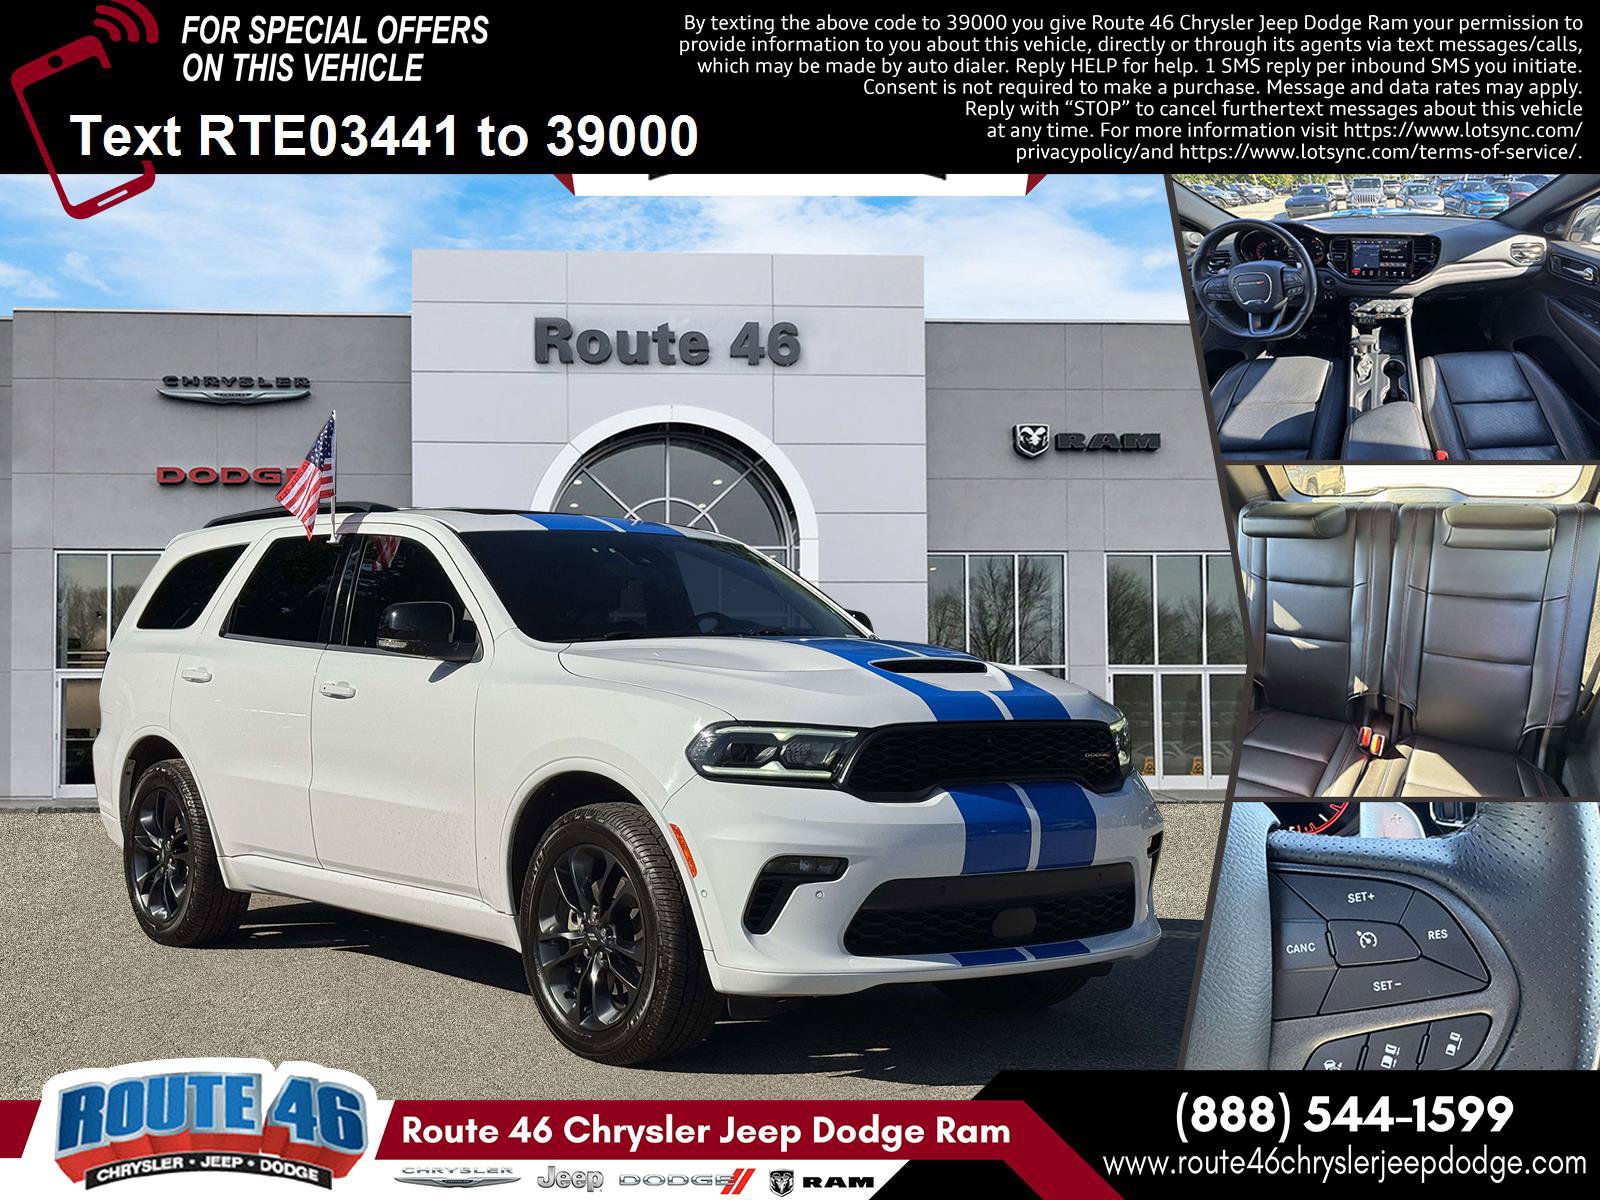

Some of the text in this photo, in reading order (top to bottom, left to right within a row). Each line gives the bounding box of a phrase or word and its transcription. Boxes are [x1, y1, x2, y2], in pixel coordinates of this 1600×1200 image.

[534, 317, 802, 367] Route 46
[162, 375, 312, 388] CHRYSLER
[1055, 432, 1162, 452] RAM
[1347, 891, 1375, 904] SET+
[1427, 928, 1449, 941] RES
[1286, 942, 1316, 954] CANC
